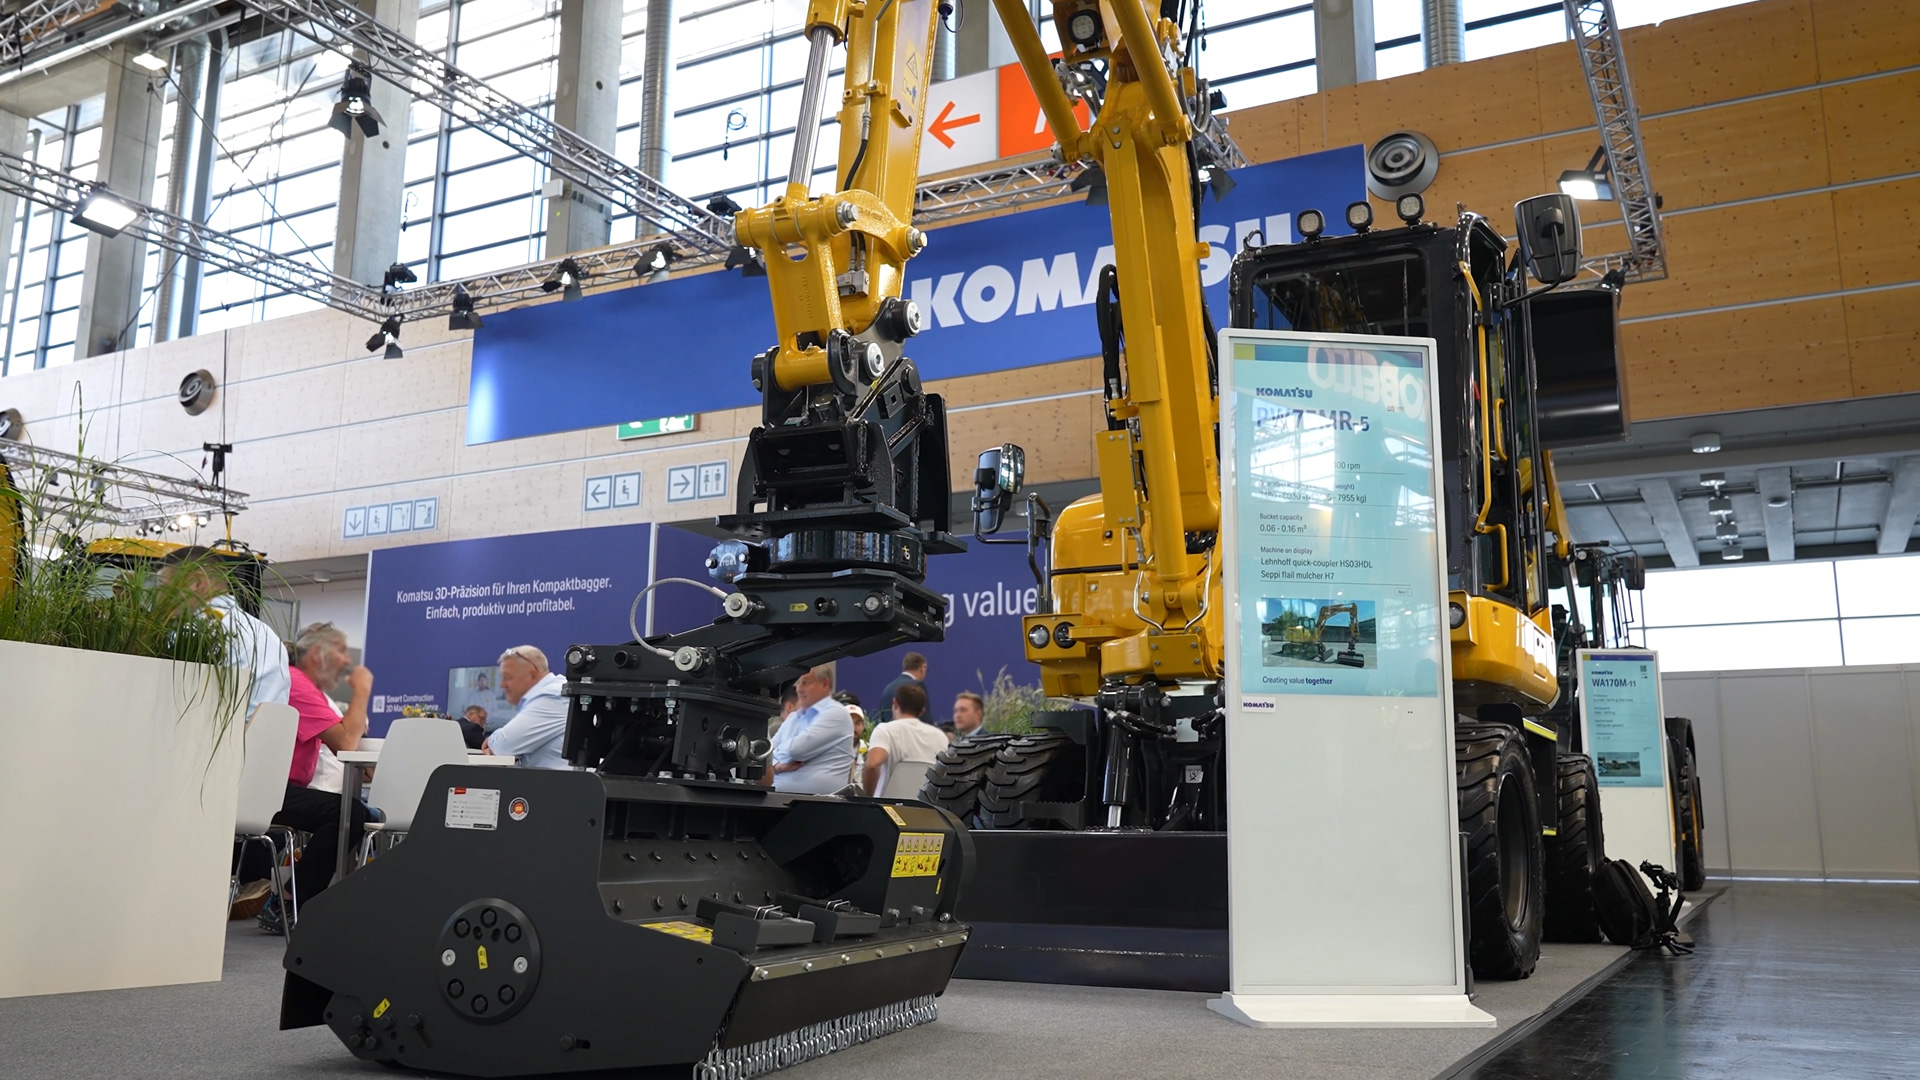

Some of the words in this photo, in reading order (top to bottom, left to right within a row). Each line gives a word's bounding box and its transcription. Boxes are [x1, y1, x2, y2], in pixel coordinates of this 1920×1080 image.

[911, 212, 1292, 332] KOMS
[1256, 387, 1313, 399] KOMATSU
[1256, 406, 1370, 432] PW7MR-5
[1347, 462, 1361, 471] rpm
[1337, 493, 1355, 502] 7955
[1280, 514, 1303, 522] capacity
[1260, 524, 1276, 532] 0.06
[1281, 524, 1296, 533] 0.16
[1260, 546, 1284, 554] Machine
[1293, 547, 1313, 556] display
[1260, 557, 1291, 566] Lehnhoff
[1292, 558, 1338, 569] quick-coupler
[1340, 559, 1373, 569] HS03HDL
[1260, 570, 1281, 580] Seppi
[1281, 571, 1295, 579] flail
[1296, 572, 1323, 580] mulcher
[1325, 572, 1335, 580] H7
[396, 589, 434, 603] Komatsu
[434, 584, 491, 601] 3D-Präzision
[492, 582, 505, 596] für
[506, 581, 531, 595] Ihren
[532, 577, 612, 595] Kompaktbagger.
[962, 581, 1038, 618] value
[426, 604, 461, 620] Einfach,
[462, 601, 506, 620] produktiv
[507, 600, 525, 614] und
[526, 597, 576, 616] profitabel.
[1262, 675, 1288, 686] Creating
[1288, 677, 1305, 685] value
[1305, 677, 1333, 686] together
[1591, 678, 1637, 688] WA170M-11
[386, 694, 403, 704] Smart
